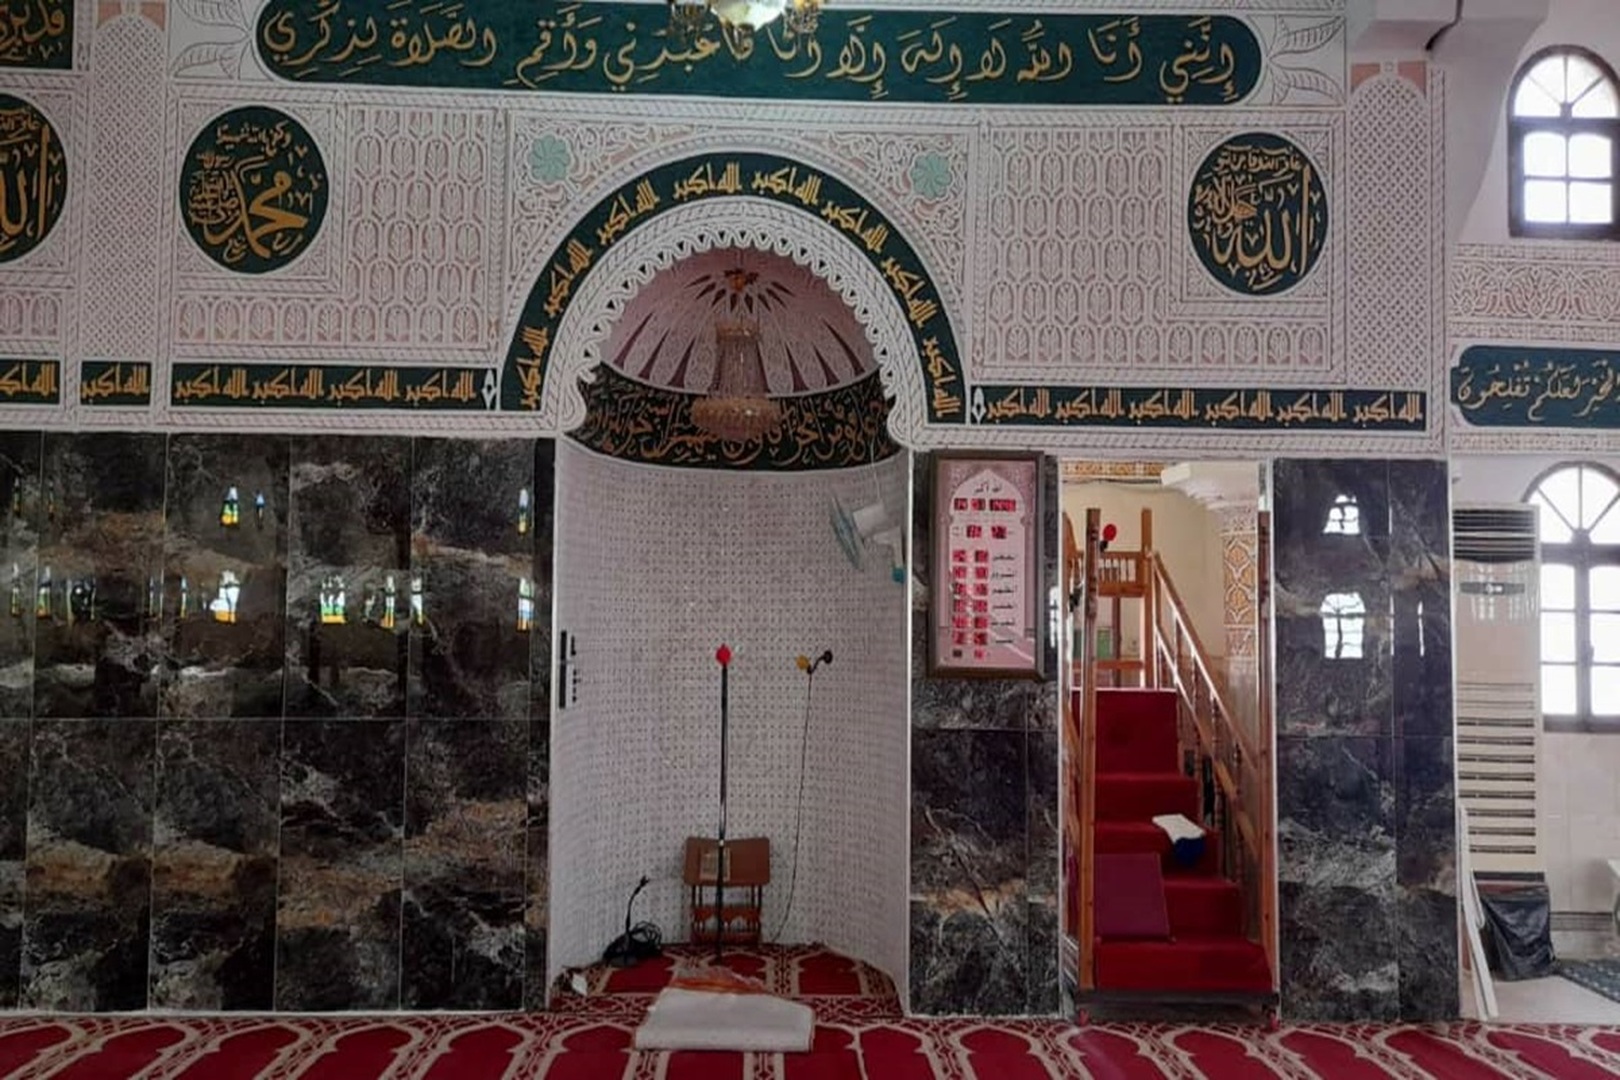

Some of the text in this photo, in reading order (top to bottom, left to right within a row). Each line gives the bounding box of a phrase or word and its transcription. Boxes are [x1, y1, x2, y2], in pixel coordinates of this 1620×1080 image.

[390, 12, 496, 66] الصلاة
[965, 22, 1008, 82] لا
[1016, 24, 1074, 81] الله
[717, 162, 743, 194] الله
[794, 174, 822, 205] الله
[635, 177, 660, 213] الله
[203, 172, 308, 259] محمد
[1211, 164, 1311, 276] الله
[861, 223, 889, 254] الله
[566, 238, 593, 274] الله
[908, 298, 939, 329] الله
[521, 326, 549, 358] الله
[32, 362, 58, 397] الله
[124, 364, 151, 397] الله
[222, 368, 250, 399] الله
[299, 368, 325, 399] الله
[374, 369, 401, 401] الله
[450, 370, 477, 402] الله
[933, 388, 961, 418] الله
[1028, 387, 1052, 419] الله
[1100, 388, 1126, 419] الله
[1173, 387, 1200, 420] الله
[1248, 390, 1274, 422] الله
[1321, 390, 1348, 422] الله
[1398, 391, 1424, 423] الله
